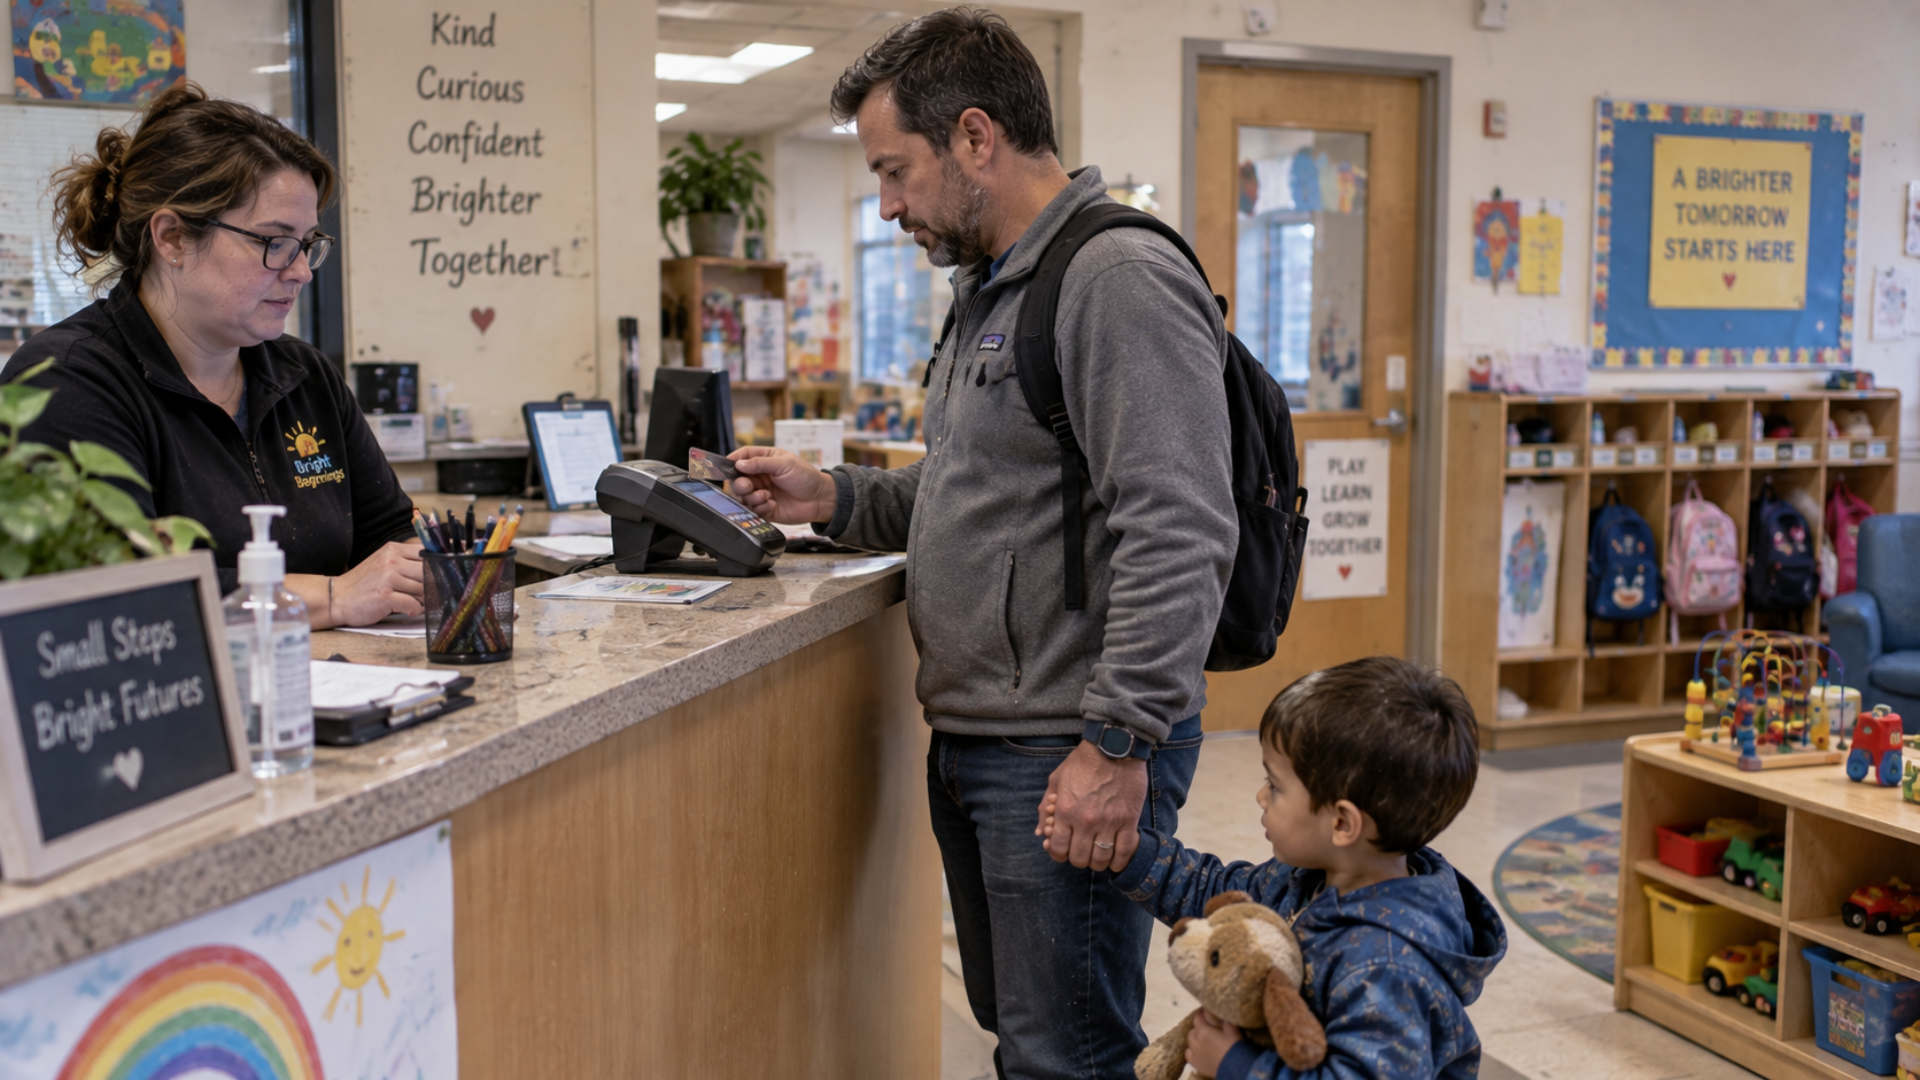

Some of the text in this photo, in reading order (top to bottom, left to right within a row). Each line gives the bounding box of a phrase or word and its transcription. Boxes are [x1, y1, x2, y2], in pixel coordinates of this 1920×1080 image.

[431, 12, 496, 47] Kind
[416, 65, 525, 103] Curious
[407, 120, 544, 163] Confident
[1671, 166, 1793, 193] A BRIGHTER
[410, 176, 542, 226] Brighter
[1674, 203, 1790, 228] TOMORROW
[1664, 238, 1796, 263] STARTS HERE
[294, 454, 332, 474] Bright
[1327, 457, 1368, 476] PLAY
[1321, 484, 1373, 503] LEARN
[1322, 511, 1371, 529] GROW
[1308, 536, 1382, 557] TOGETHER
[37, 615, 177, 679] Small Steps
[33, 675, 204, 752] Bright Futures
